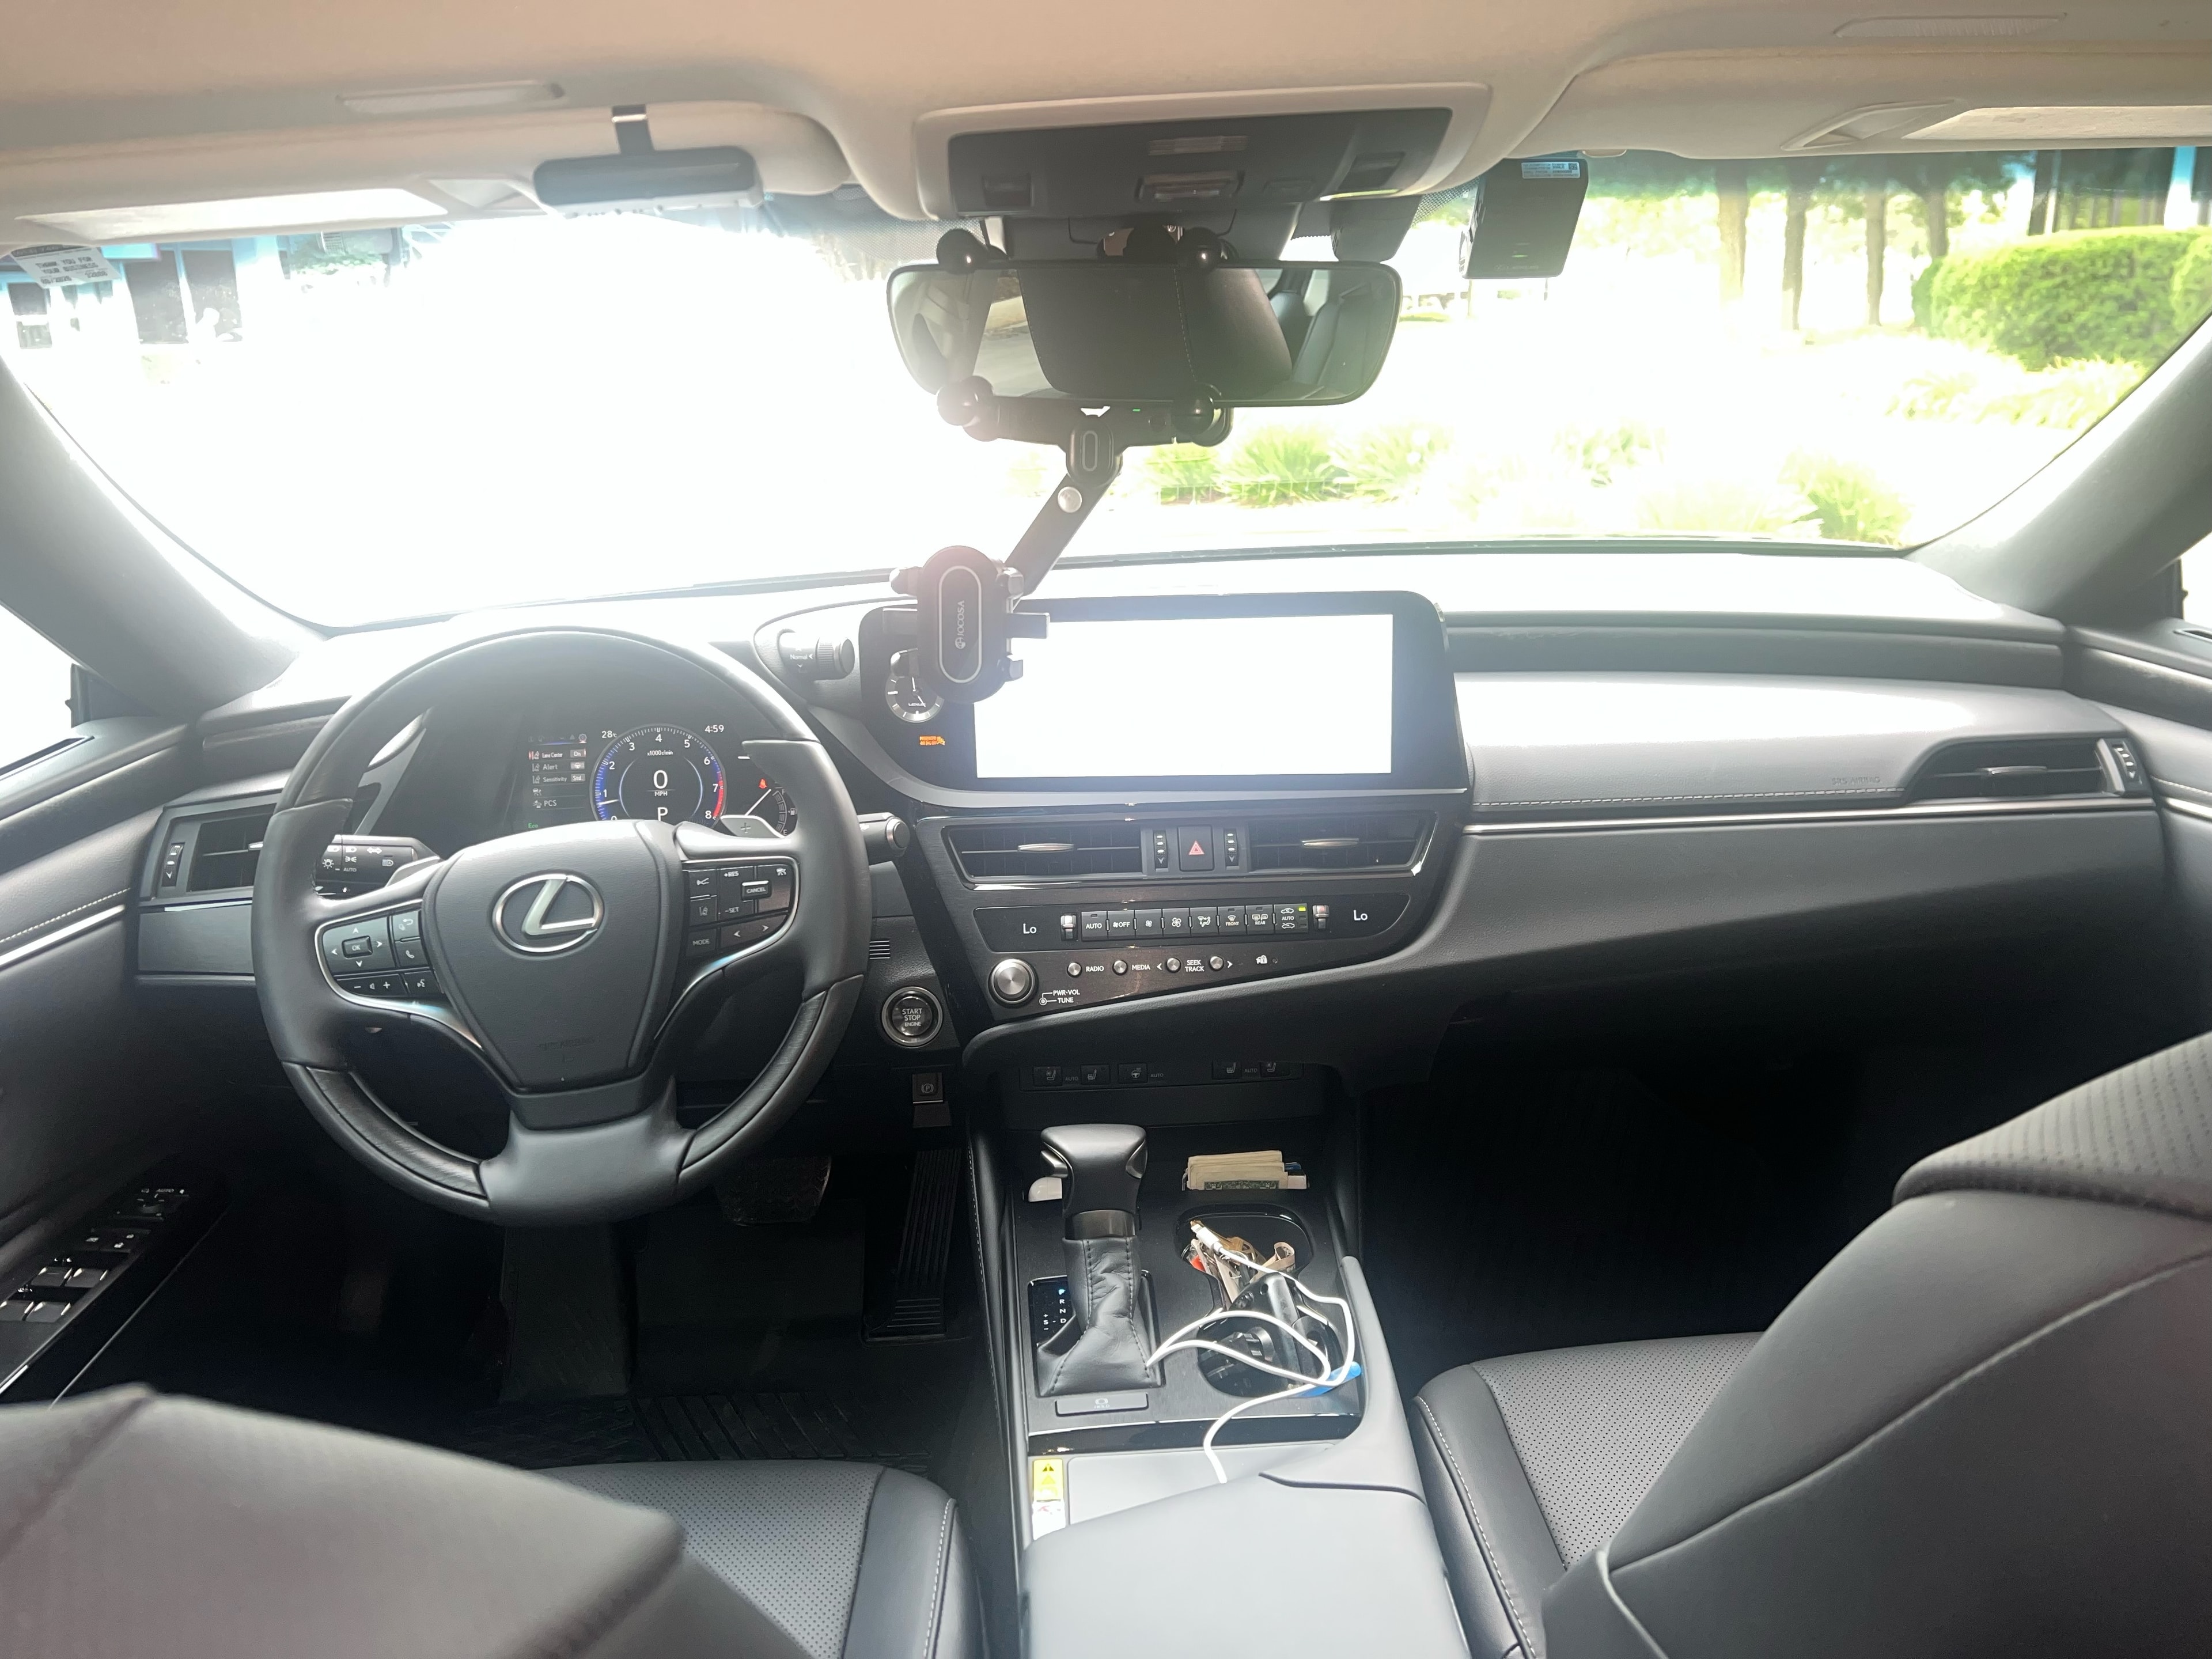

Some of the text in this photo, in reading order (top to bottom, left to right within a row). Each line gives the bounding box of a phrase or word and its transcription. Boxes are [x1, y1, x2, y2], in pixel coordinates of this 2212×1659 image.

[704, 725, 724, 733] 4:59
[655, 734, 662, 742] 4
[629, 743, 635, 751] 3
[684, 739, 690, 748] 5
[703, 757, 710, 765] 6
[609, 762, 615, 770] 2
[653, 770, 668, 789] 0
[713, 783, 718, 792] 7
[603, 789, 608, 798] 1
[657, 807, 668, 821] P
[704, 810, 712, 819] 8
[1354, 910, 1368, 921] Lo
[1022, 923, 1037, 934] Lo
